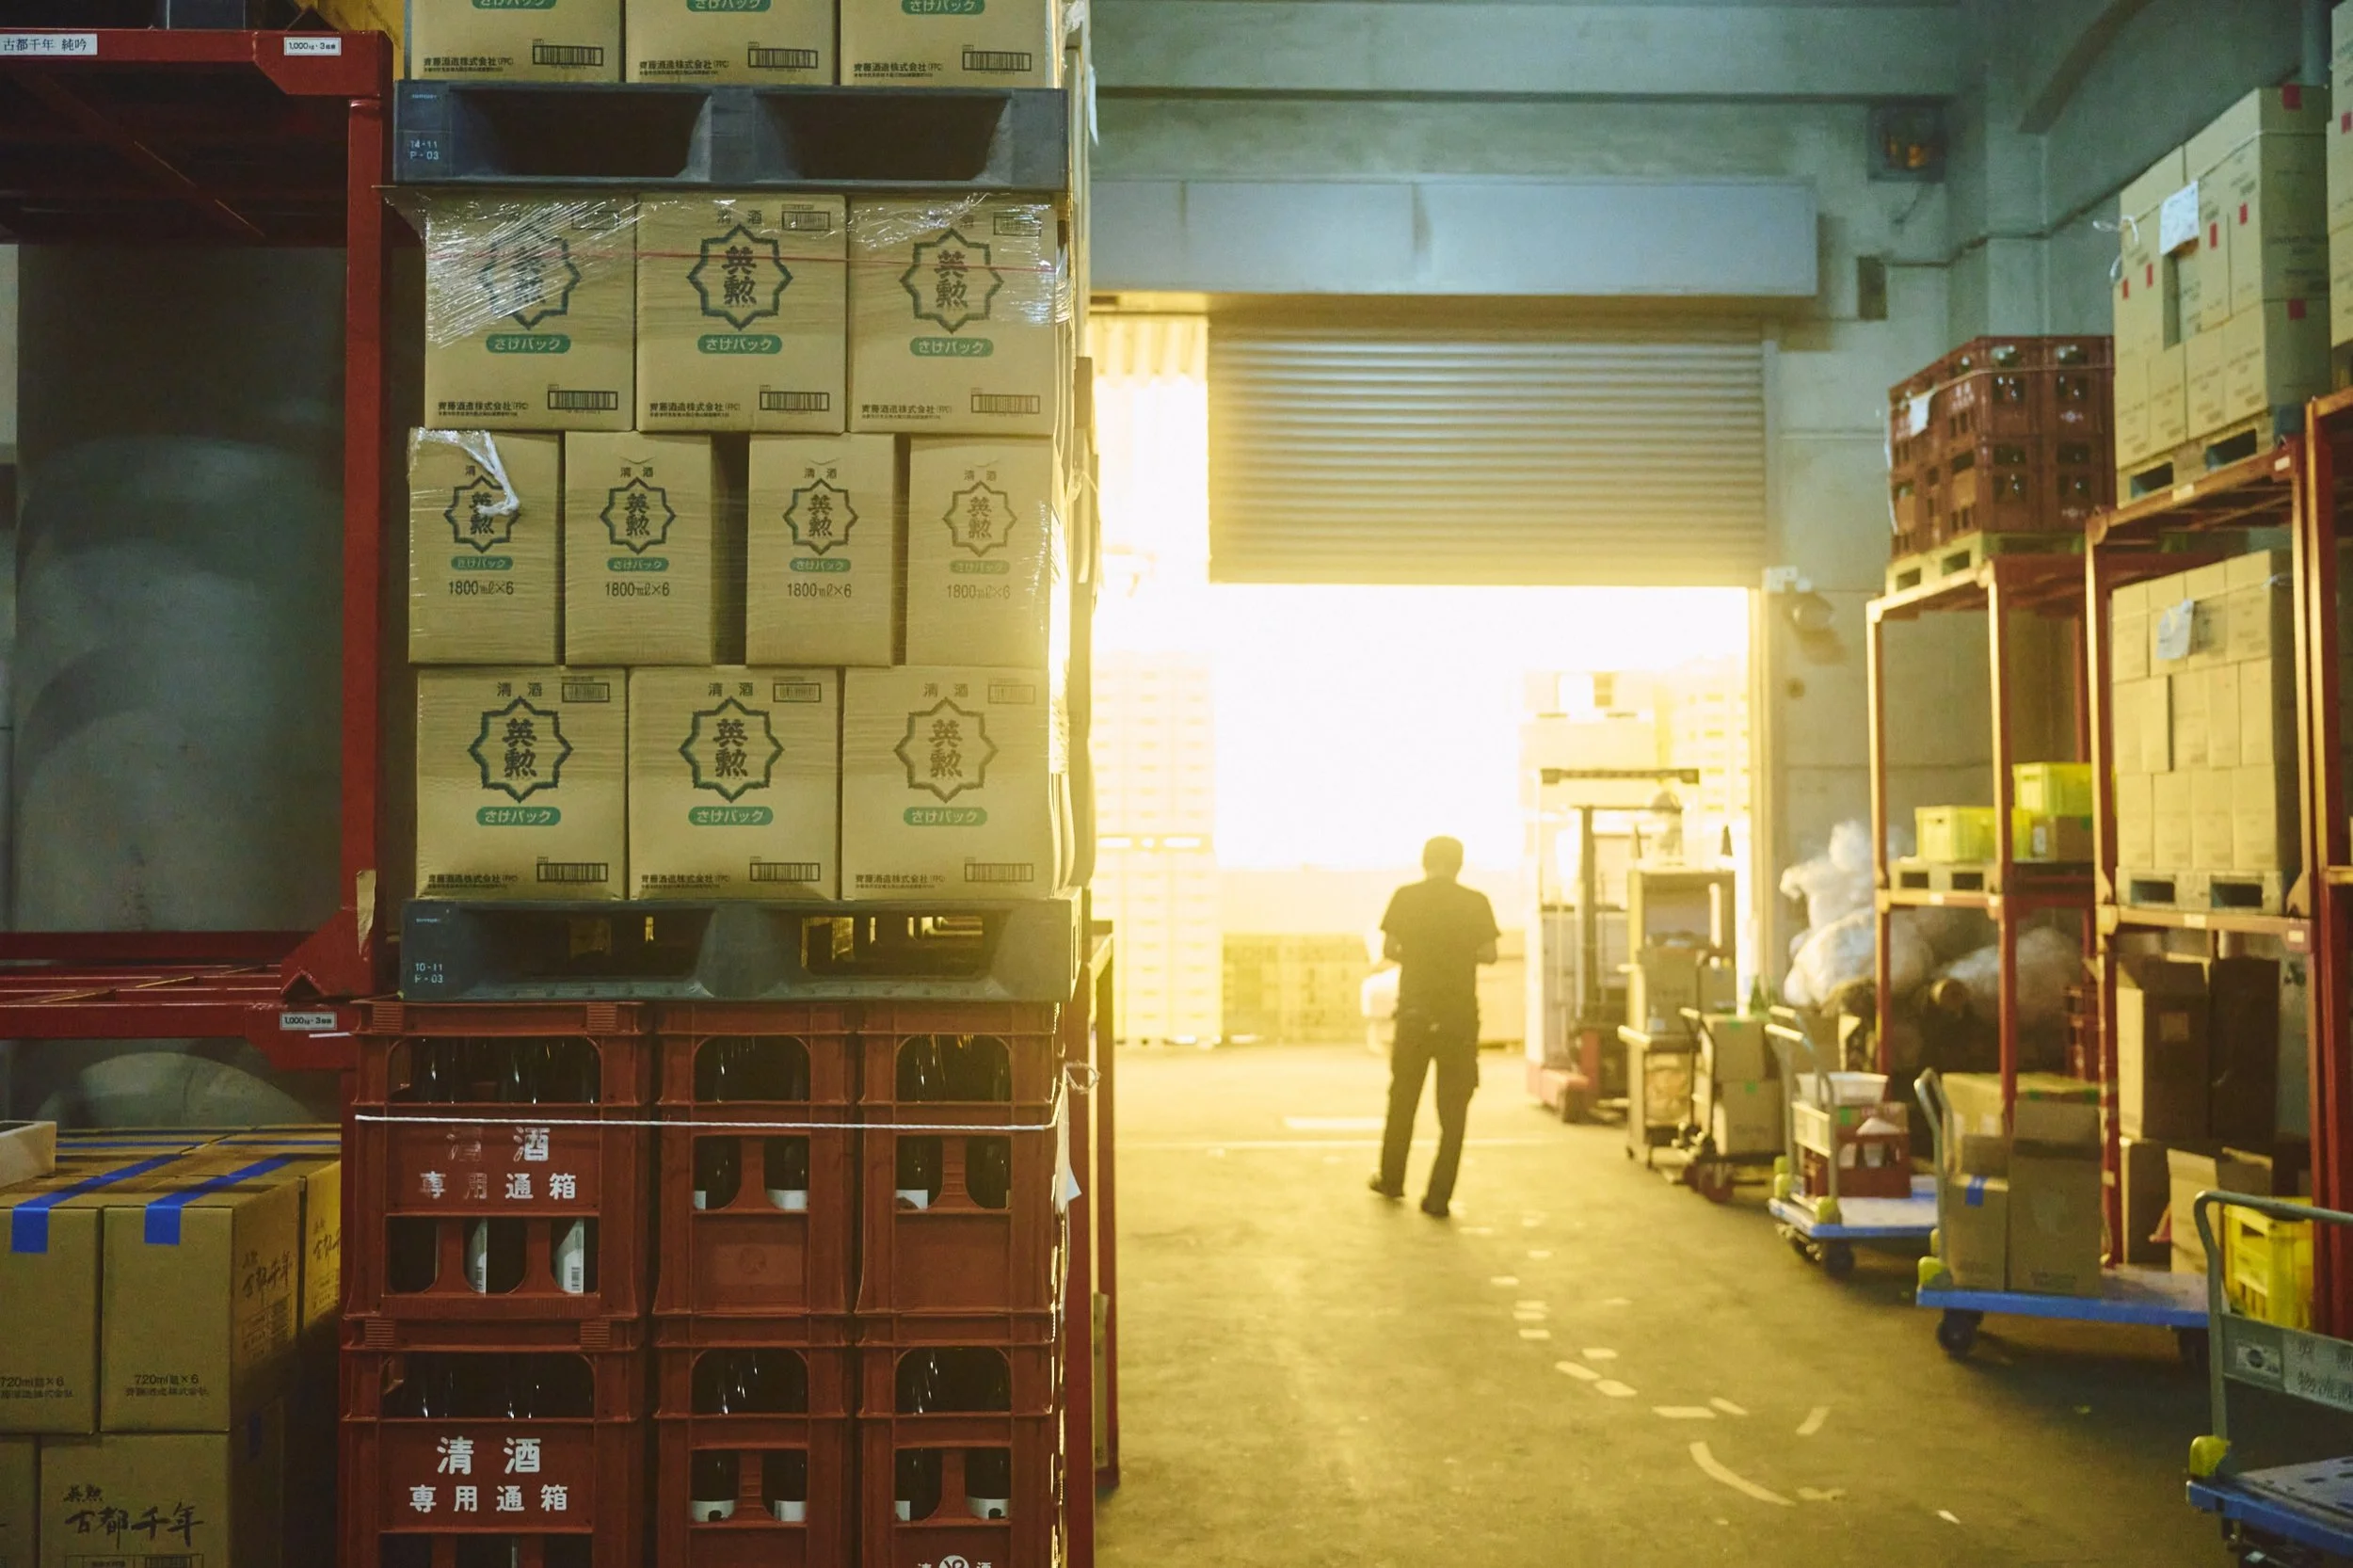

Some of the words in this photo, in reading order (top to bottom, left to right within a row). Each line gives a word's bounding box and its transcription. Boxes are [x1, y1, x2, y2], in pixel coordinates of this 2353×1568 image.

[910, 0, 976, 12] さけパック
[3, 39, 56, 51] 古都千年
[61, 39, 87, 51] 純吟
[722, 246, 758, 305] 英勲
[934, 249, 968, 308] 英勲
[494, 338, 562, 350] さけパック
[706, 338, 773, 351] さけパック
[918, 341, 984, 355] さけパック
[620, 466, 654, 478] 清酒
[804, 467, 838, 479] 清酒
[625, 493, 650, 536] 英勲
[808, 494, 833, 537] 英勲
[968, 496, 992, 538] 英勲
[497, 681, 542, 697] 清酒
[708, 681, 753, 696] 清酒
[923, 682, 968, 698] 清酒
[503, 718, 537, 777] 英勲
[713, 718, 748, 777] 英勲
[928, 719, 963, 777] 英勲
[485, 810, 552, 824] さけパック
[696, 810, 764, 824] さけパック
[912, 810, 979, 824] さけパック
[437, 1436, 541, 1475] 清酒
[409, 1484, 568, 1513] 専用通箱
[64, 1498, 204, 1550] 古都千年
